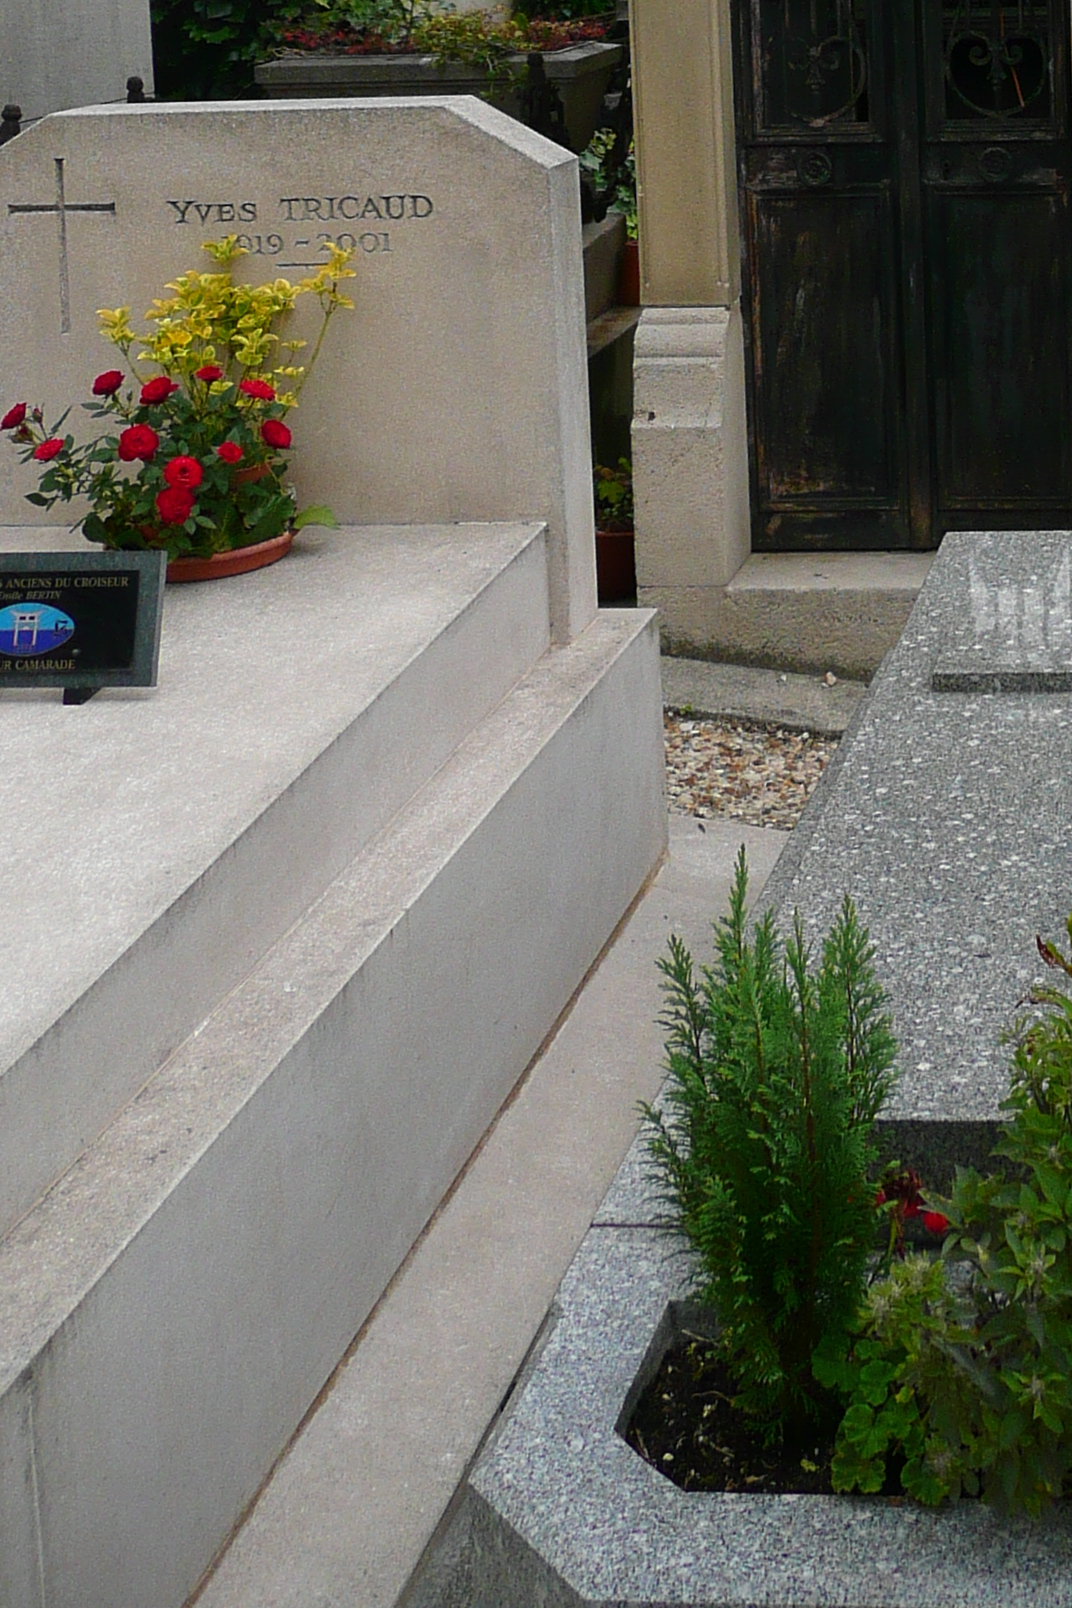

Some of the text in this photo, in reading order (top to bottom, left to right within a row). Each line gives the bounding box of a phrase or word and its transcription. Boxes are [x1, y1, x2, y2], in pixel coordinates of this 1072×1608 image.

[166, 194, 434, 226] YVES TRICAUD
[221, 233, 284, 255] 919
[316, 232, 394, 254] 2001
[5, 577, 52, 589] ANCIENS
[55, 577, 71, 588] DU
[74, 576, 129, 588] CROISEUR
[15, 658, 76, 671] CAMARADE
